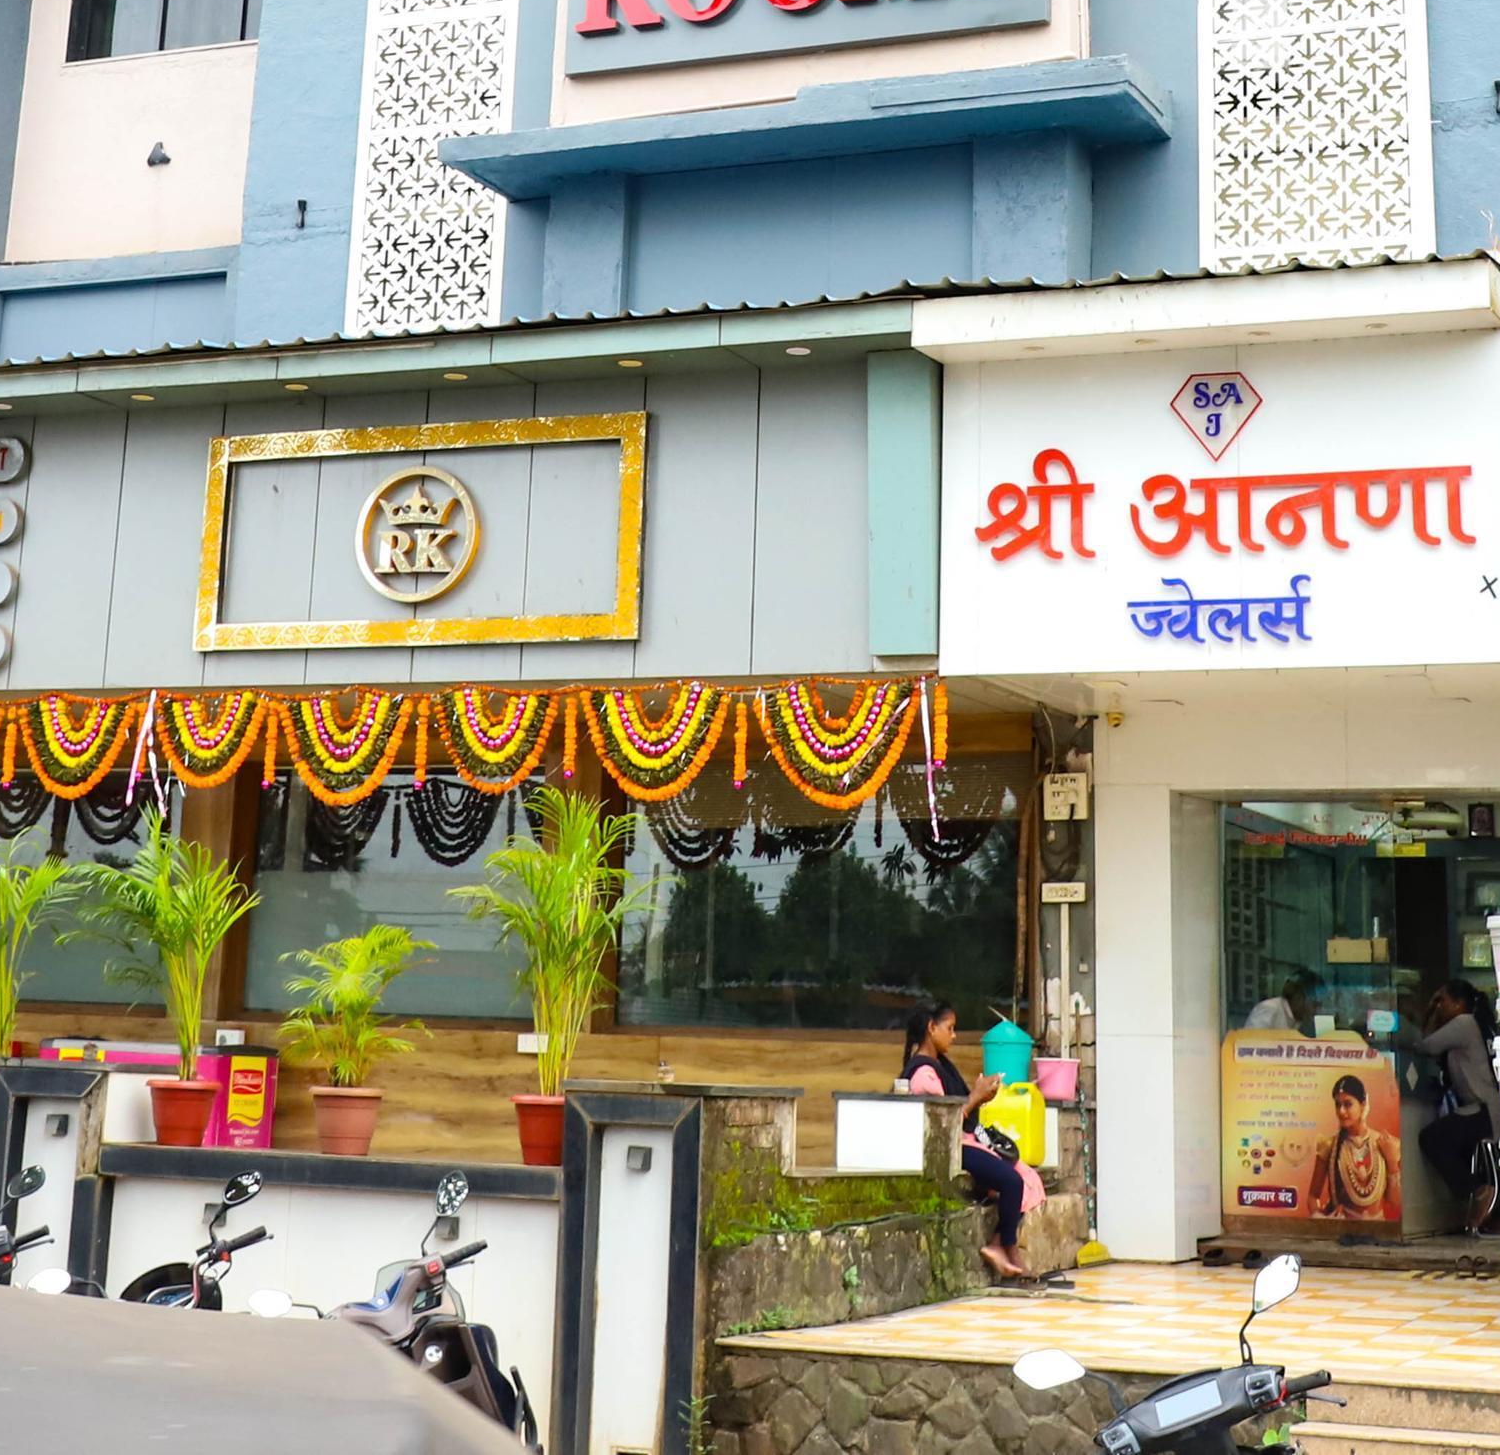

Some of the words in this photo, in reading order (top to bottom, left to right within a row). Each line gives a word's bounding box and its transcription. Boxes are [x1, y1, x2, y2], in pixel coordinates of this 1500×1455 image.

[975, 448, 1096, 561] श्री
[1130, 465, 1477, 559] आनणा
[374, 528, 458, 576] RK
[1127, 574, 1312, 644] ज्वेलर्स
